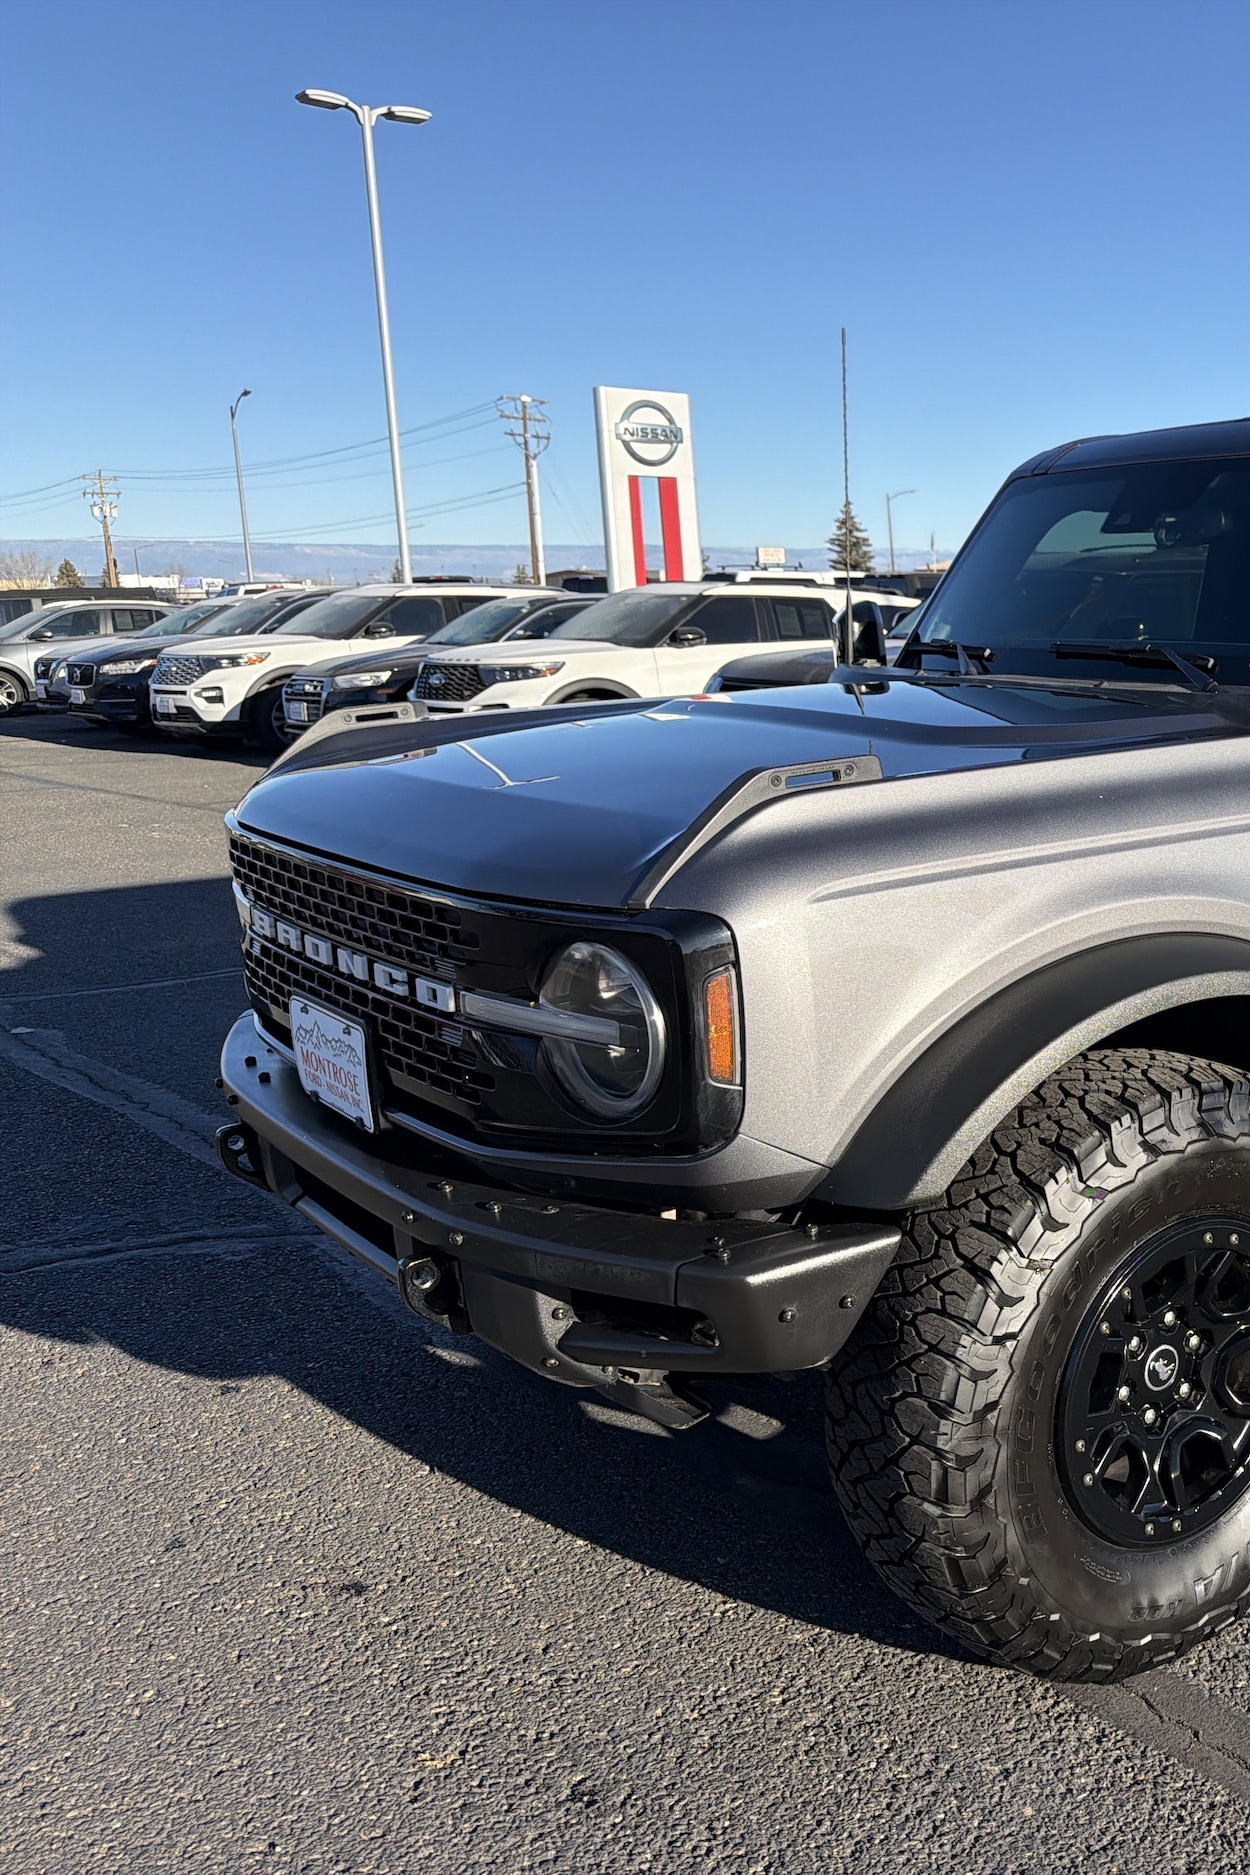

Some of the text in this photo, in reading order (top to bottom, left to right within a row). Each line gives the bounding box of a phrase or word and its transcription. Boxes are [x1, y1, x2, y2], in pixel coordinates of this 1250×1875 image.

[623, 427, 679, 440] NISSAN
[252, 904, 456, 1012] BRONCO
[300, 1045, 361, 1097] MONTROSE
[304, 1069, 323, 1088] FORD
